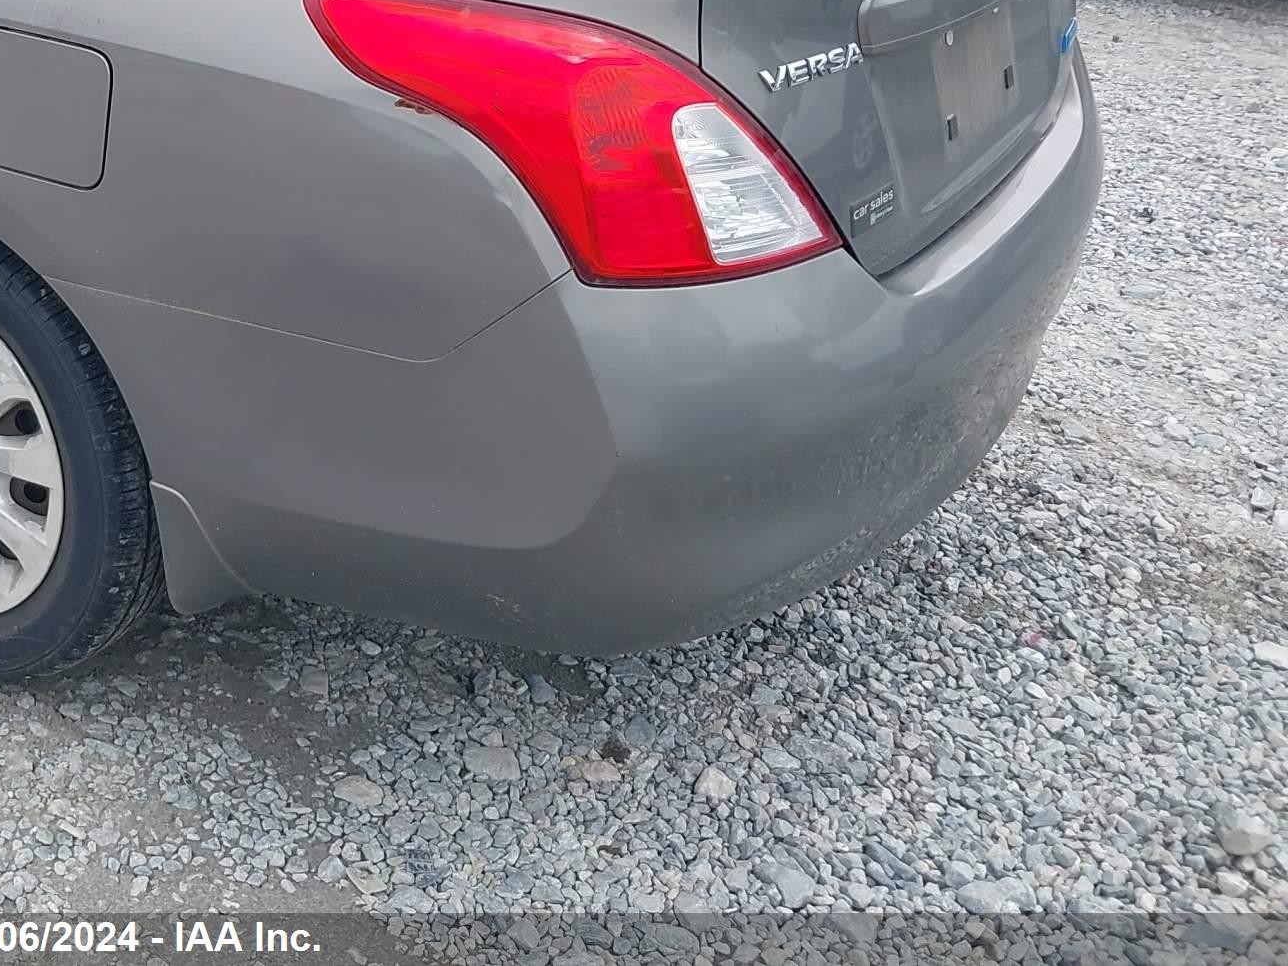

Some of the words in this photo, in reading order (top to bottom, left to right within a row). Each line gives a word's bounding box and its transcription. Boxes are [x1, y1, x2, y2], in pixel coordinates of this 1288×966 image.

[757, 42, 864, 92] VERSA
[853, 203, 869, 220] car
[870, 189, 894, 211] sales
